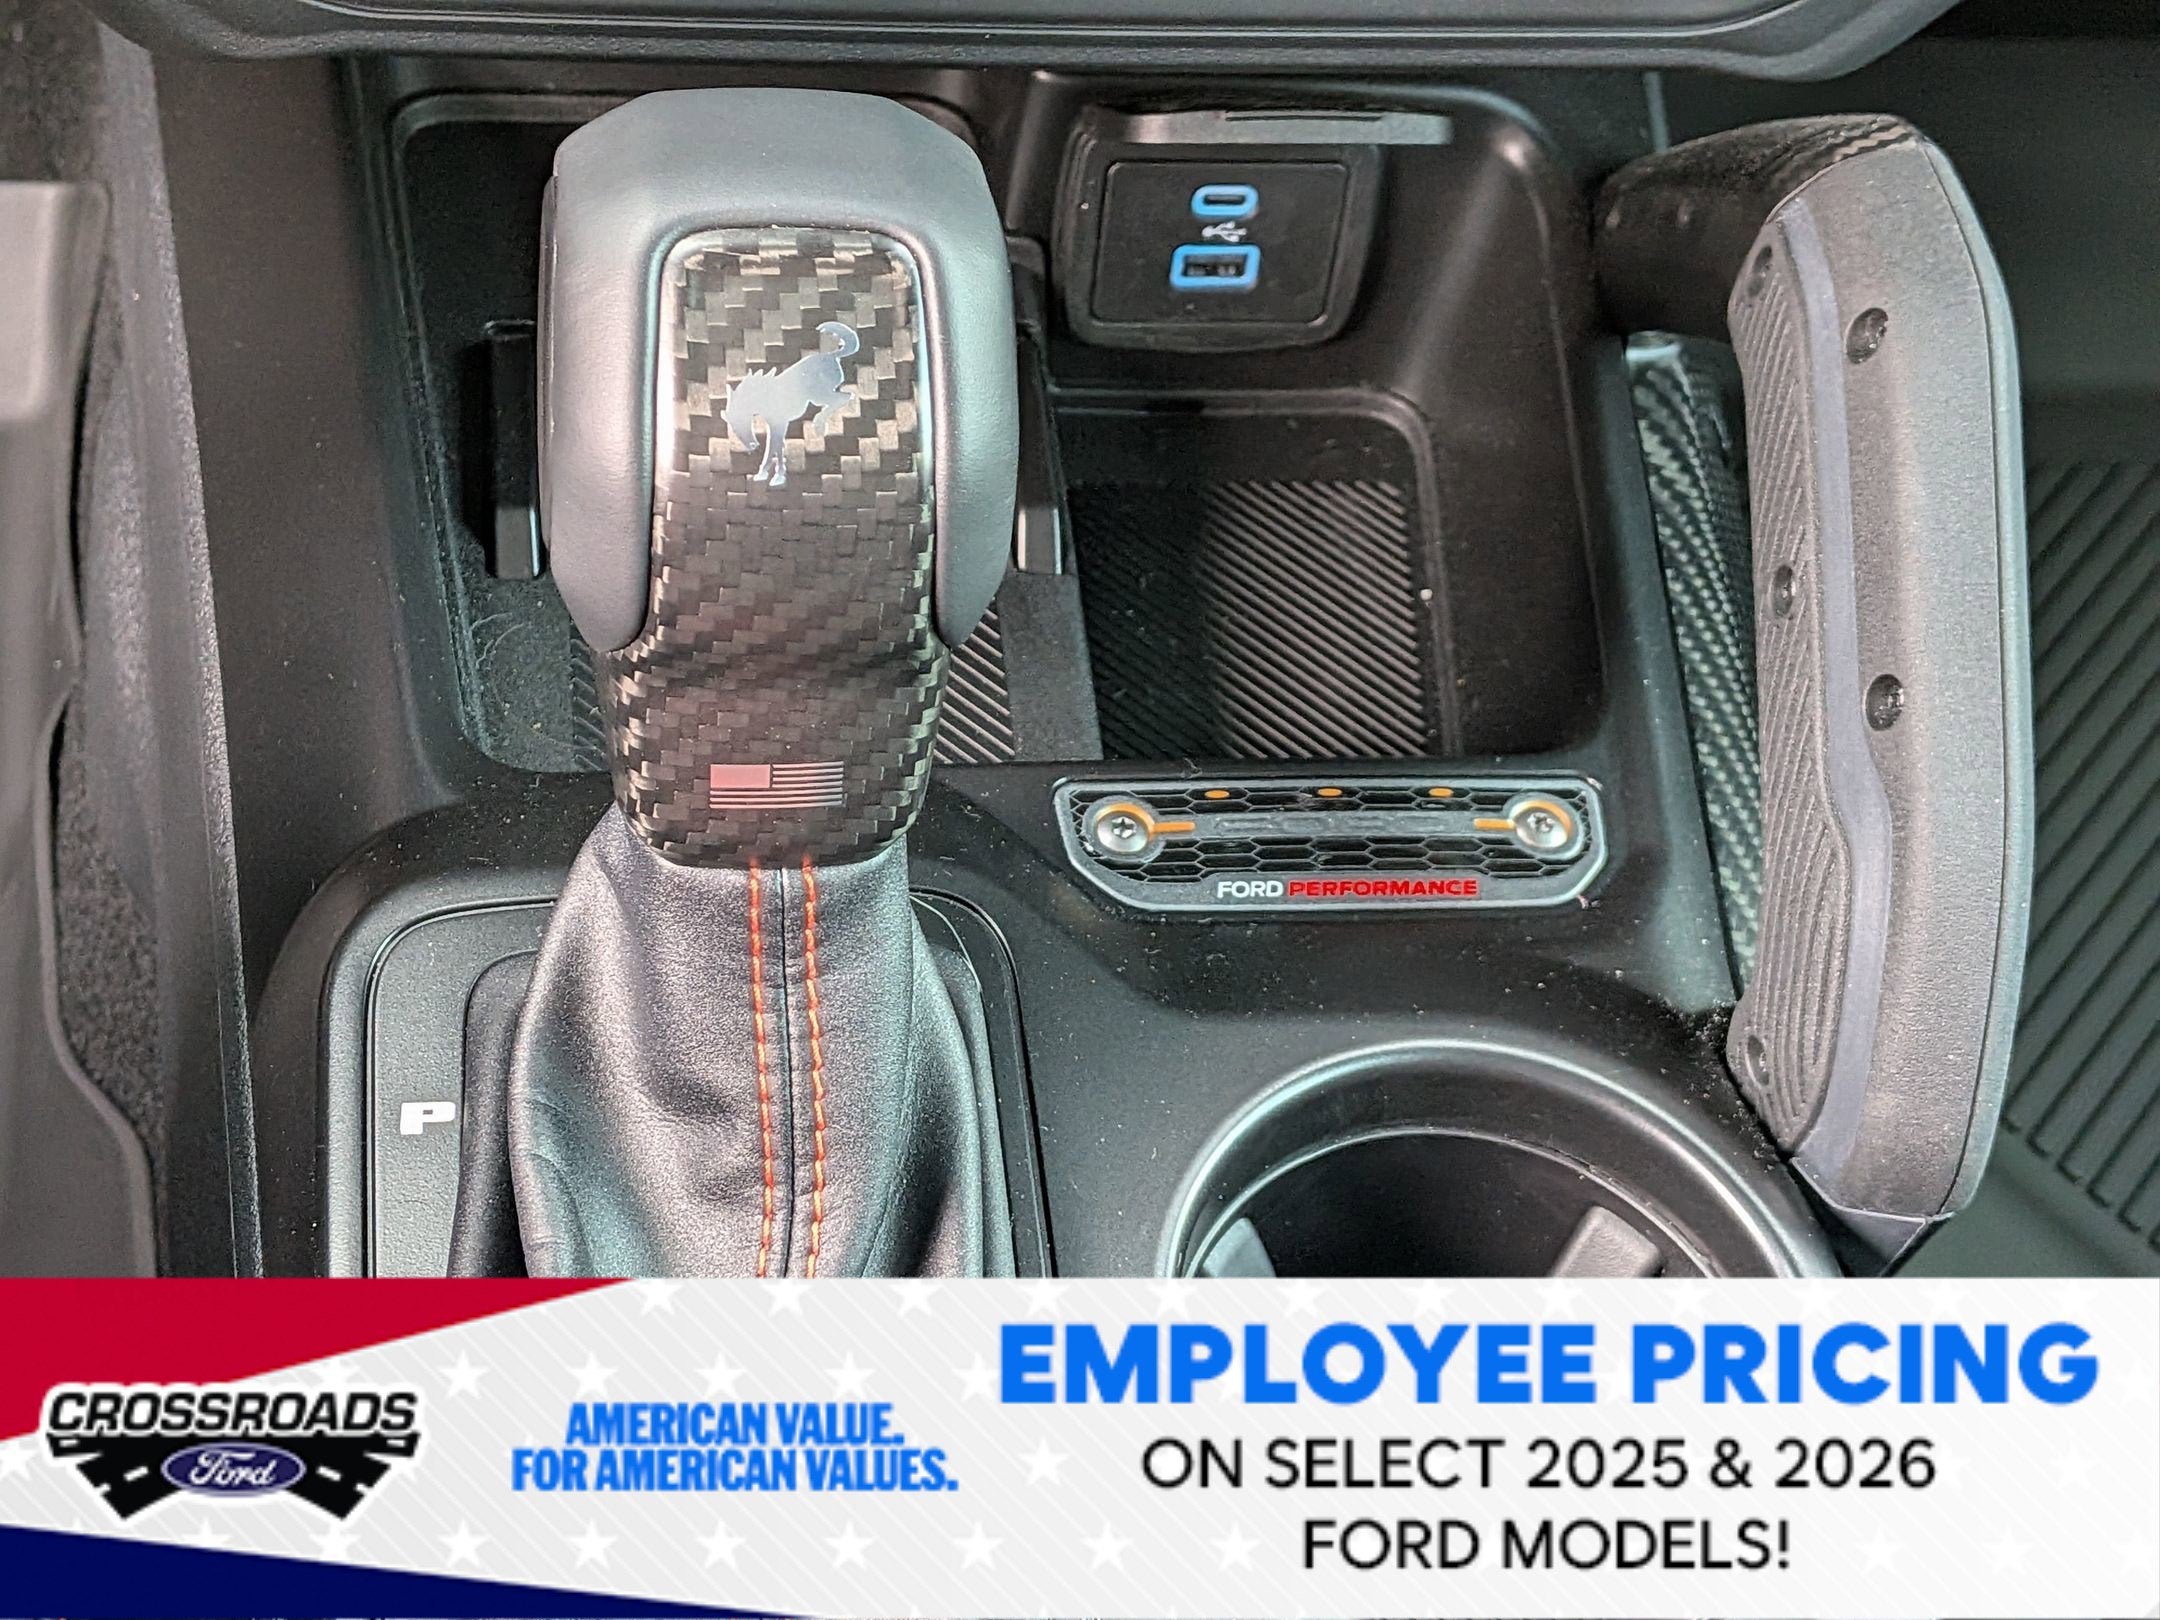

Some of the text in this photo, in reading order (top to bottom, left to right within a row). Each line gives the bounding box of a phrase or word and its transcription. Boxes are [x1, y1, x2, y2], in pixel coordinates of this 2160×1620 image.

[1216, 879, 1478, 899] FORD PERFORMANCE
[401, 1102, 456, 1135] P
